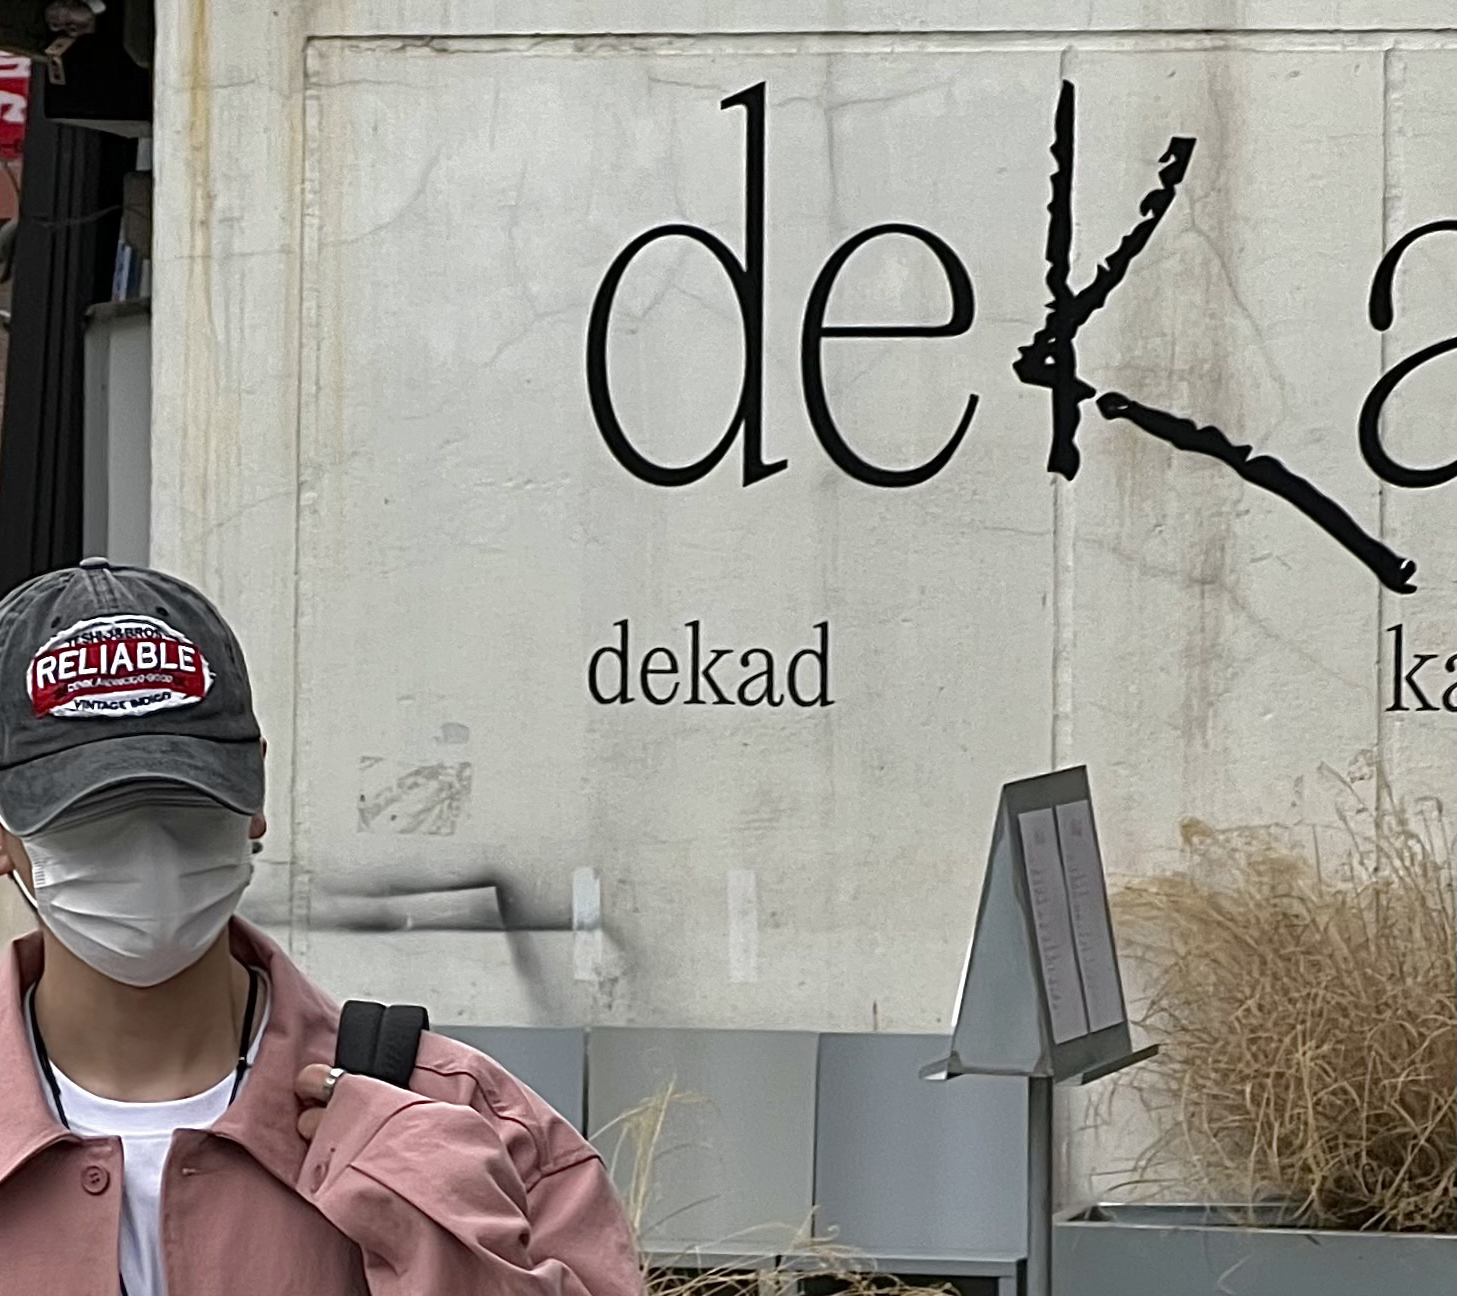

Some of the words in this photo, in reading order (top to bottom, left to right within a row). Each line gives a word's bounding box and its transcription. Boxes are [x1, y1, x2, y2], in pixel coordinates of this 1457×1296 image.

[36, 642, 196, 689] RELIABLE
[587, 619, 836, 707] dekad
[74, 699, 128, 711] VINTAGE
